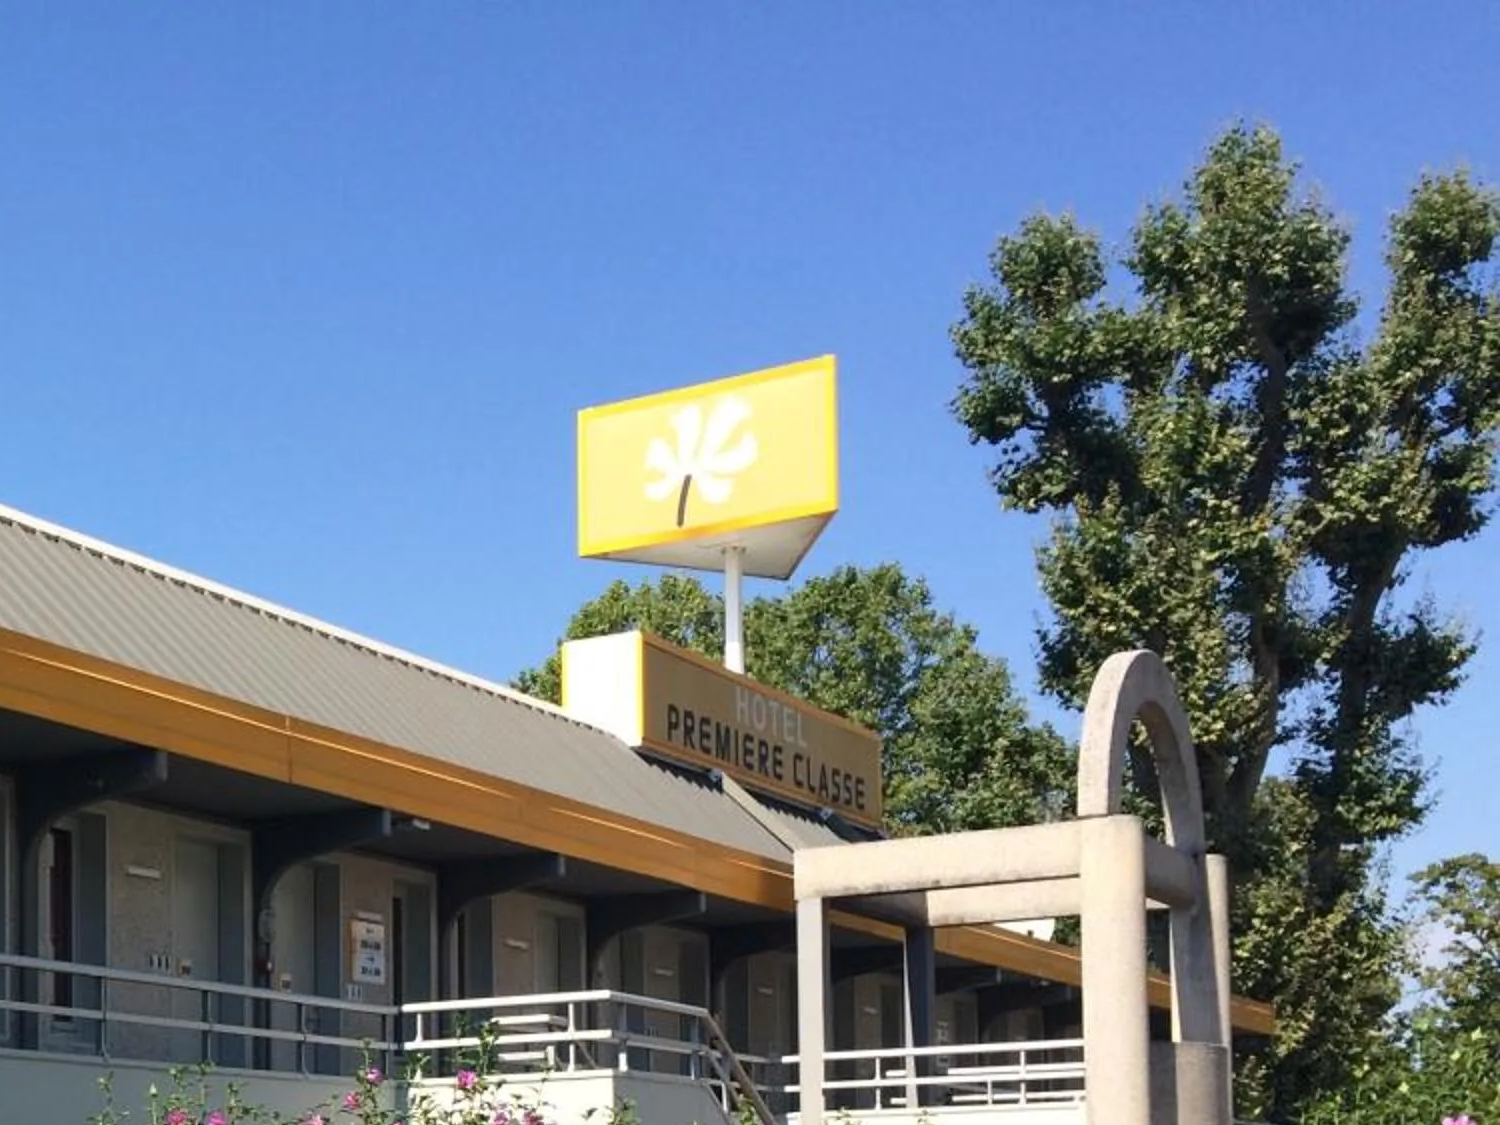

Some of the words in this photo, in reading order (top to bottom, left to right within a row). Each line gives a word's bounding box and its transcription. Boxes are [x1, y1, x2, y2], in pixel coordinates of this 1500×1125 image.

[667, 703, 784, 782] PREMIERE
[792, 753, 866, 810] CLASSE
[735, 686, 808, 748] HOTEL
